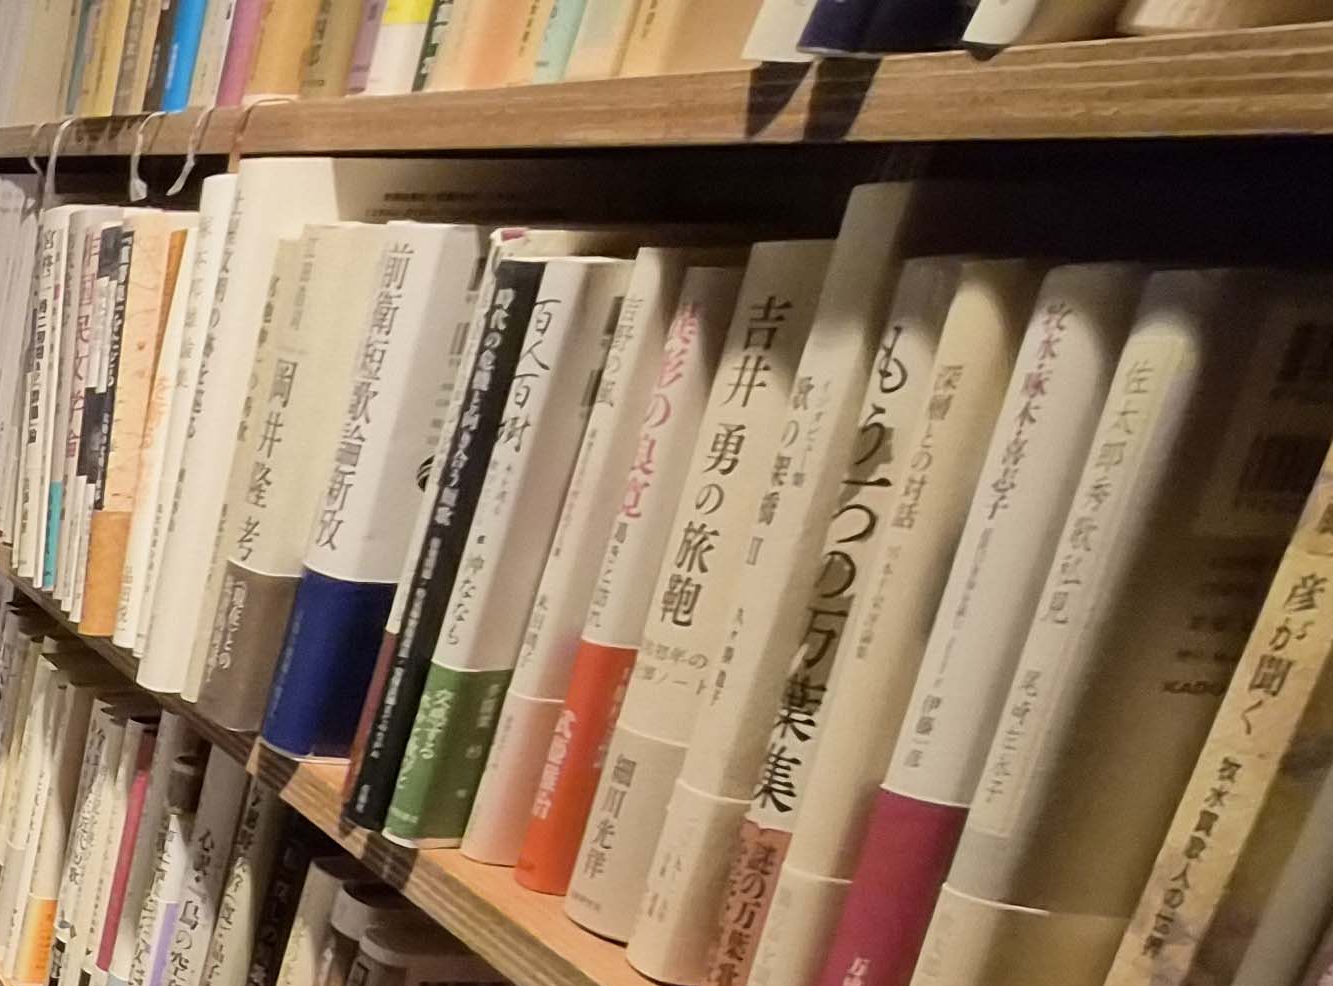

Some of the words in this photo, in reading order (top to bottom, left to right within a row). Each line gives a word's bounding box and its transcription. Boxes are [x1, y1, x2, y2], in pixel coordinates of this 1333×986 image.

[315, 241, 414, 551] 前衛短歌論新攷
[498, 299, 562, 452] 百人百樹
[661, 297, 792, 627] 吉井勇の旅鞄
[753, 323, 909, 815] もう一つの万葉集
[583, 755, 637, 879] 細川光洋
